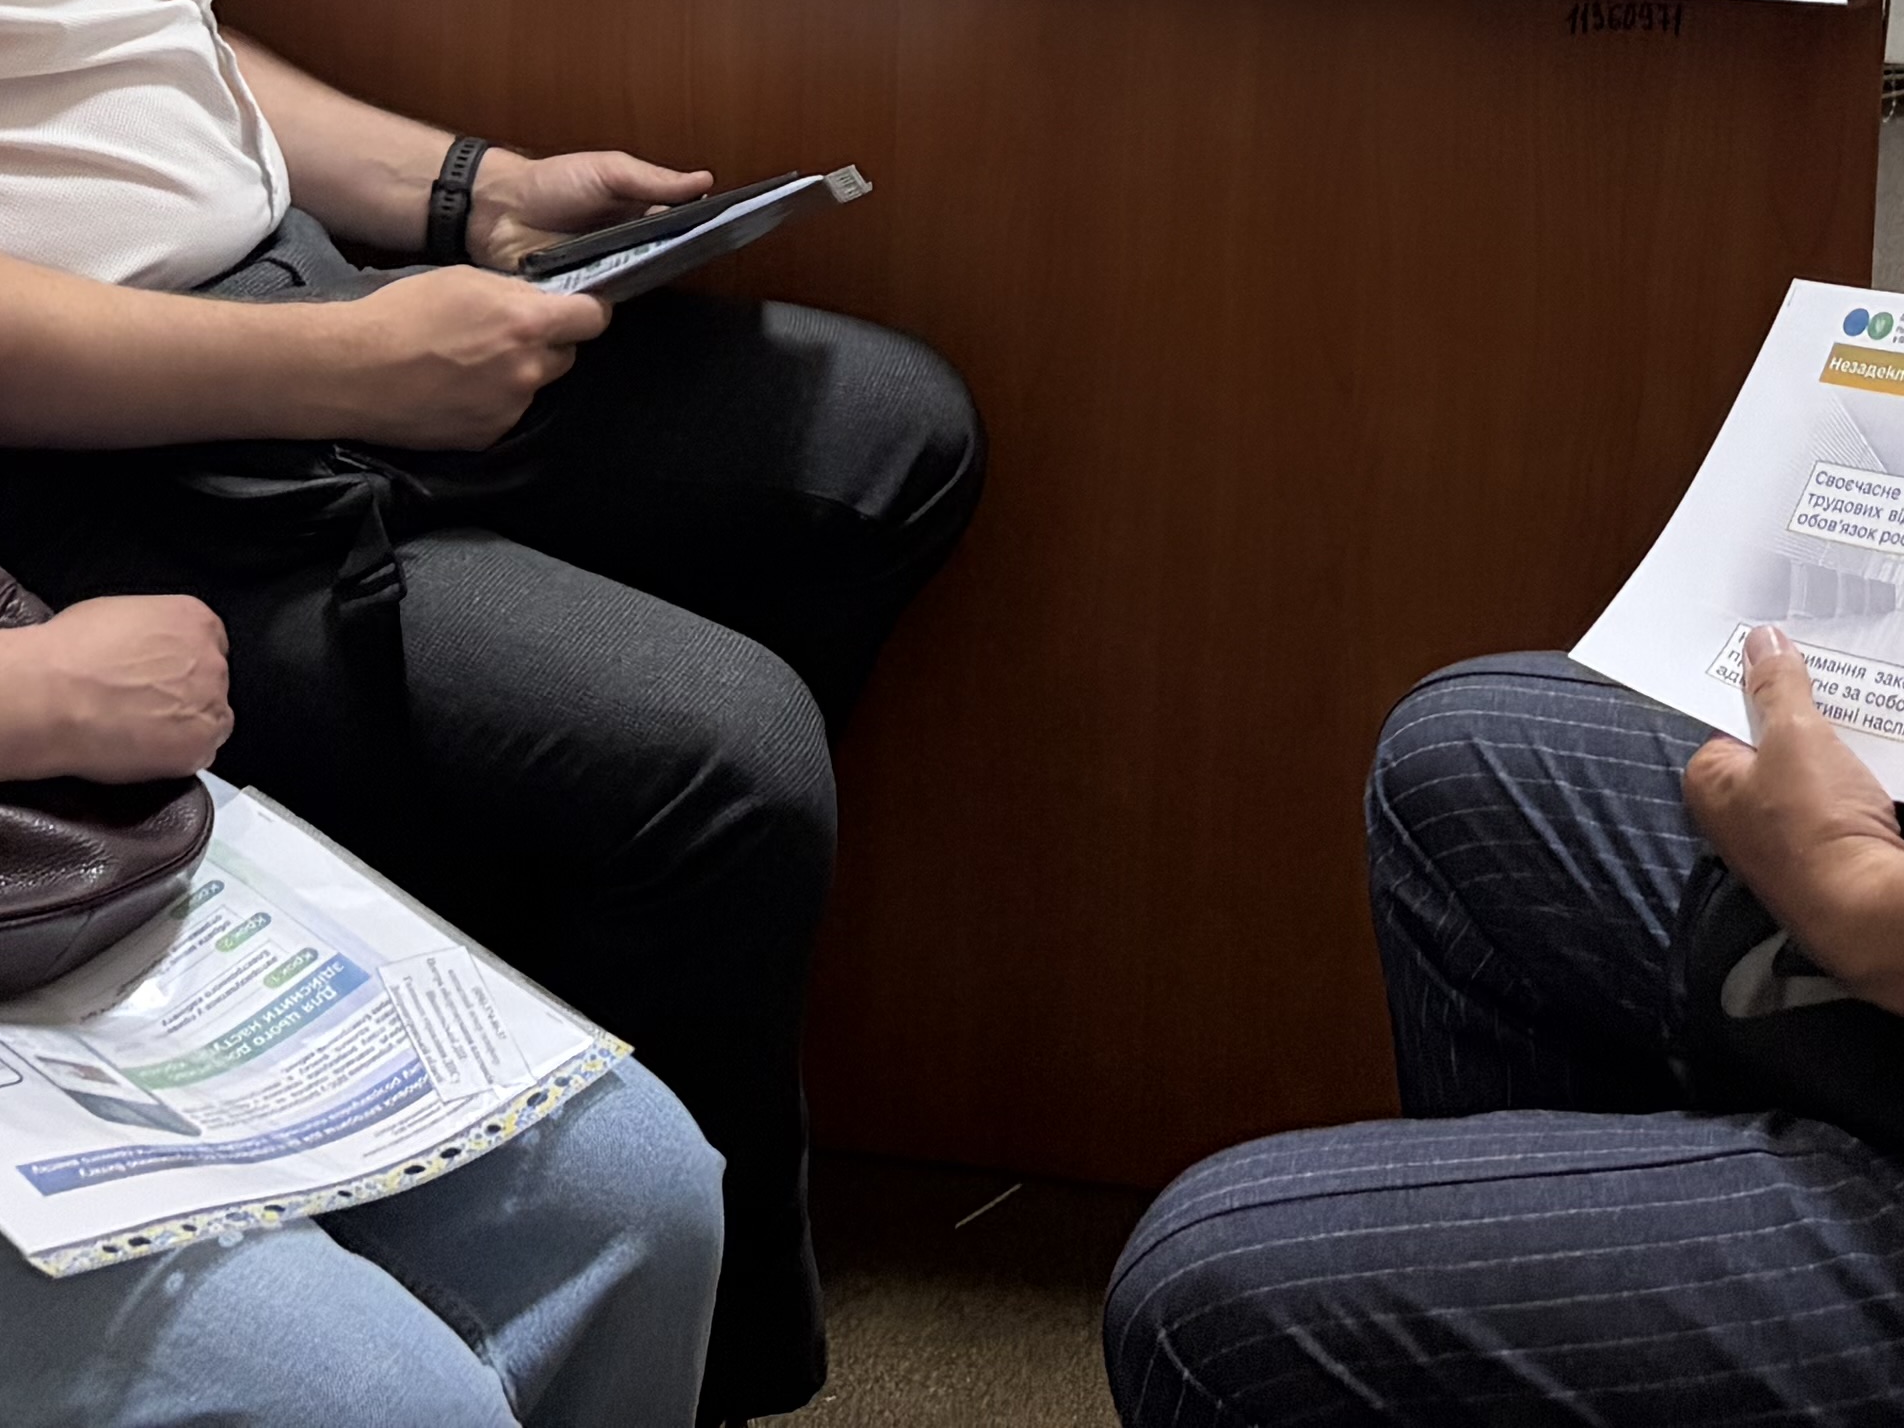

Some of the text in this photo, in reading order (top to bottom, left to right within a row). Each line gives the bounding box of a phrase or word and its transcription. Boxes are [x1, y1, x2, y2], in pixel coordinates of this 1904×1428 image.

[1815, 470, 1902, 501] Своєчасне
[1808, 492, 1884, 520] трудових
[1796, 512, 1878, 541] обов'язок
[1842, 685, 1861, 702] за
[262, 961, 344, 1023] здійснити
[253, 985, 339, 1046] Для цього
